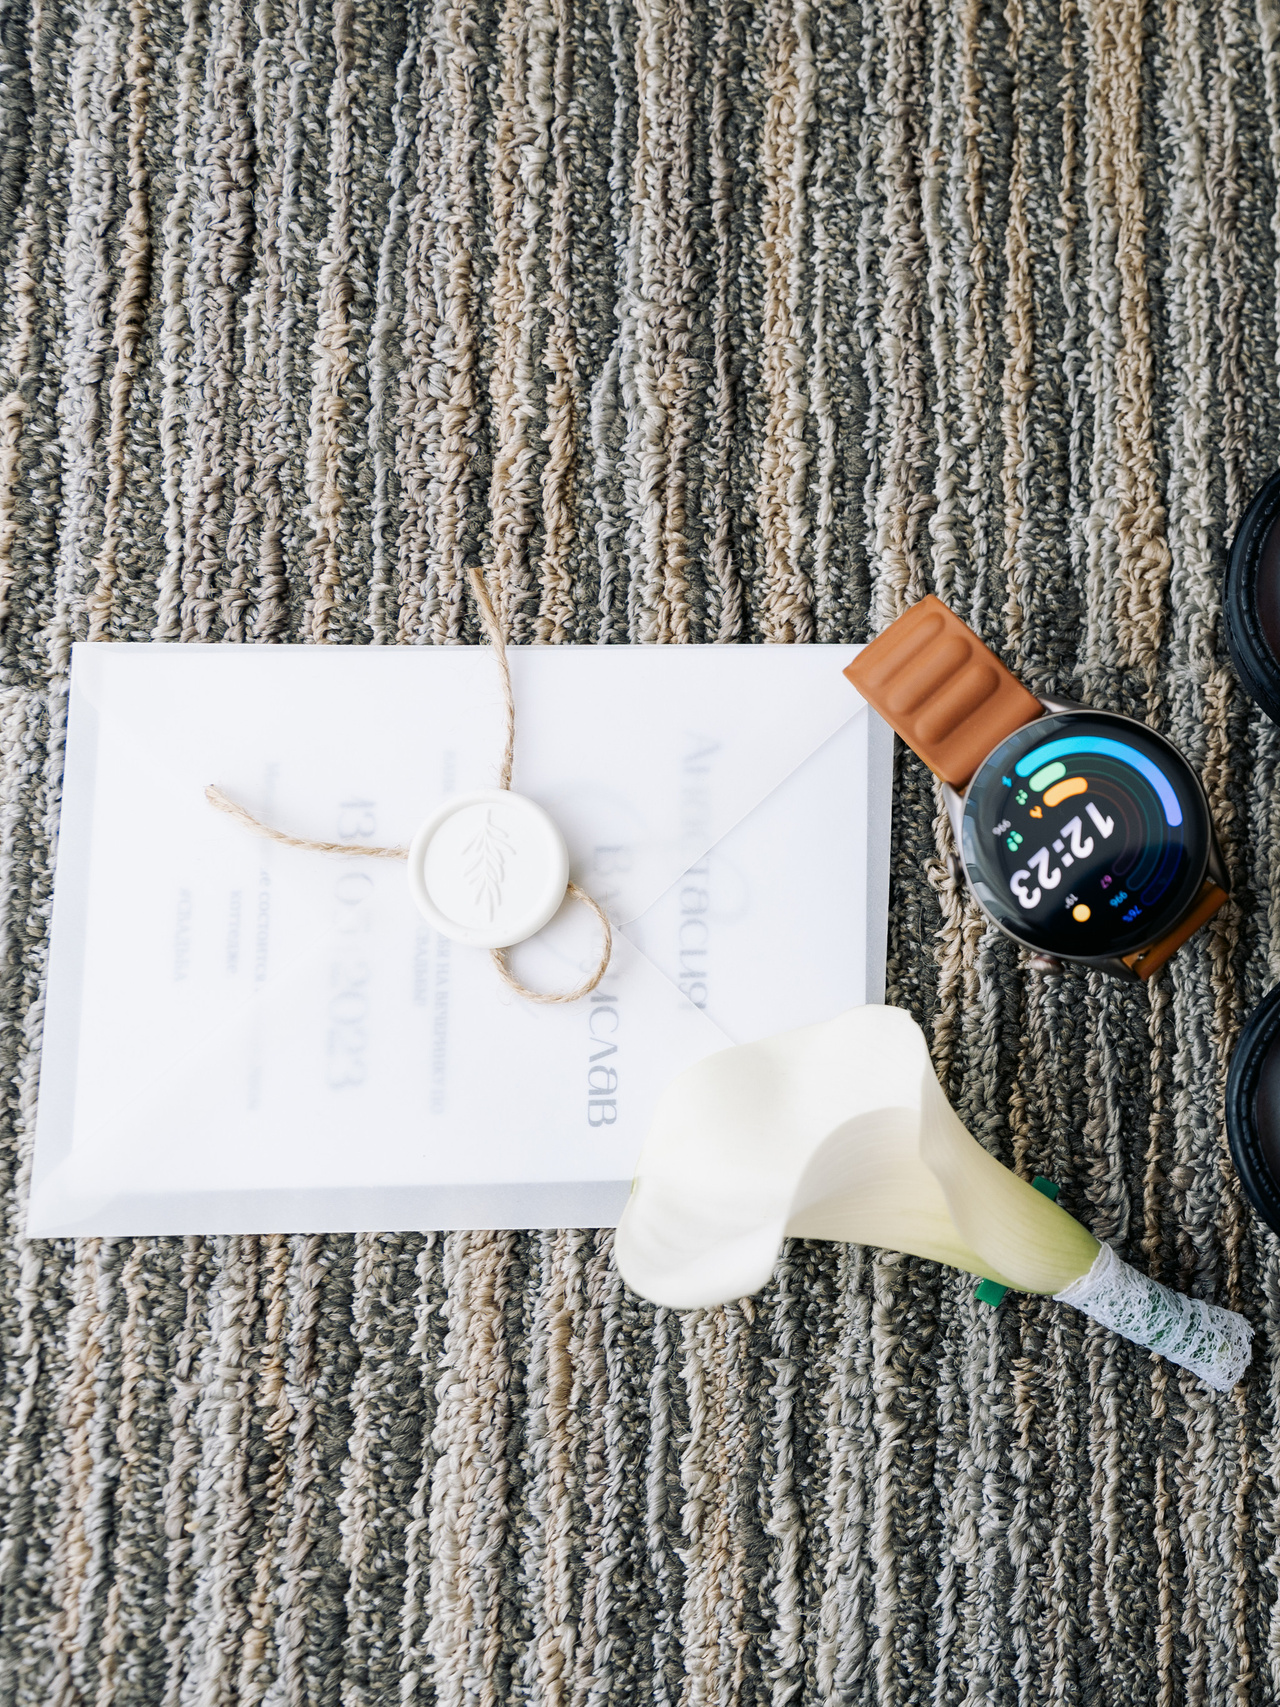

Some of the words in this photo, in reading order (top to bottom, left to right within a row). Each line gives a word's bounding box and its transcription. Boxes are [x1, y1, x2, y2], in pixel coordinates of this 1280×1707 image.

[992, 819, 1012, 837] 996
[1009, 801, 1115, 910] 12:23
[1100, 874, 1113, 890] 67
[1108, 889, 1129, 908] 996
[1122, 904, 1143, 923] 76%
